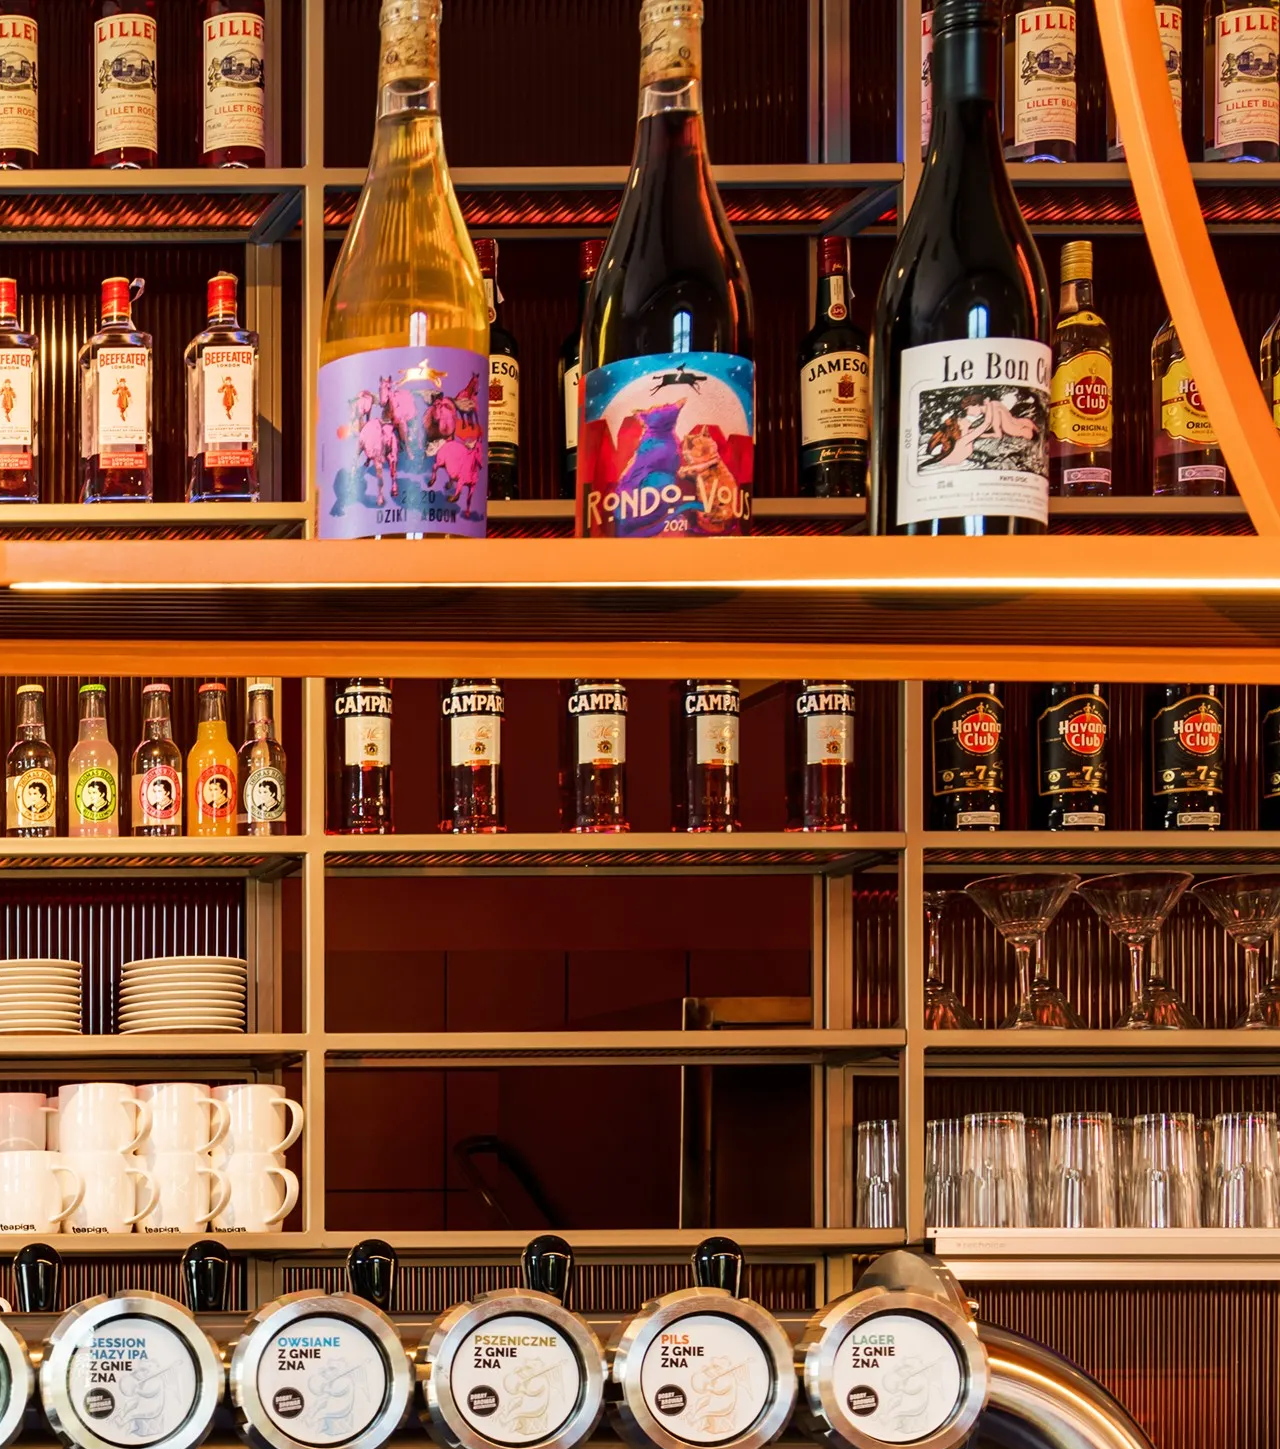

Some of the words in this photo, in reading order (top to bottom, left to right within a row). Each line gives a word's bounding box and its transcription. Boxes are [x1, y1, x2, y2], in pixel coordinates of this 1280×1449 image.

[1021, 13, 1075, 34] LILLE
[1221, 14, 1277, 37] LILLE
[214, 104, 243, 115] LILLET
[1027, 98, 1058, 109] LILLET
[1226, 99, 1259, 111] LILLET
[105, 106, 134, 117] LILLET
[100, 353, 146, 368] BEEFEATER
[205, 351, 252, 366] BEEFEATER
[808, 358, 869, 382] JAMESO
[943, 355, 973, 382] Le
[985, 352, 1029, 381] Bon
[1076, 395, 1106, 409] Club
[376, 509, 407, 524] DZIKI
[663, 519, 687, 532] 2021
[952, 720, 1001, 735] Havana
[1059, 720, 1106, 735] Havana
[1173, 720, 1221, 735] Havana
[964, 733, 994, 746] Club
[1071, 734, 1100, 747] Club
[1186, 734, 1215, 747] Club
[975, 765, 986, 780] 7
[1081, 766, 1094, 780] 7
[1196, 766, 1208, 780] 7
[90, 1338, 146, 1349] SESSION
[277, 1337, 340, 1347] OWSIANE
[474, 1335, 557, 1347] PSZENICZNE
[661, 1334, 689, 1345] PILS
[852, 1334, 895, 1345] LAGER
[90, 1349, 124, 1360] HAZY
[128, 1350, 148, 1360] IPA
[278, 1349, 286, 1359] Z
[289, 1349, 321, 1359] GNIE
[474, 1347, 482, 1357] Z
[486, 1347, 517, 1357] GNIE
[661, 1347, 669, 1356] Z
[672, 1346, 704, 1357] GNIE
[852, 1347, 860, 1357] Z
[864, 1346, 896, 1357] GNIE
[90, 1361, 98, 1372] Z
[101, 1361, 133, 1372] GNIE
[278, 1361, 305, 1371] ZNA
[474, 1359, 501, 1369] ZNA
[661, 1358, 688, 1368] ZNA
[852, 1359, 880, 1368] ZNA
[90, 1373, 117, 1383] ZNA
